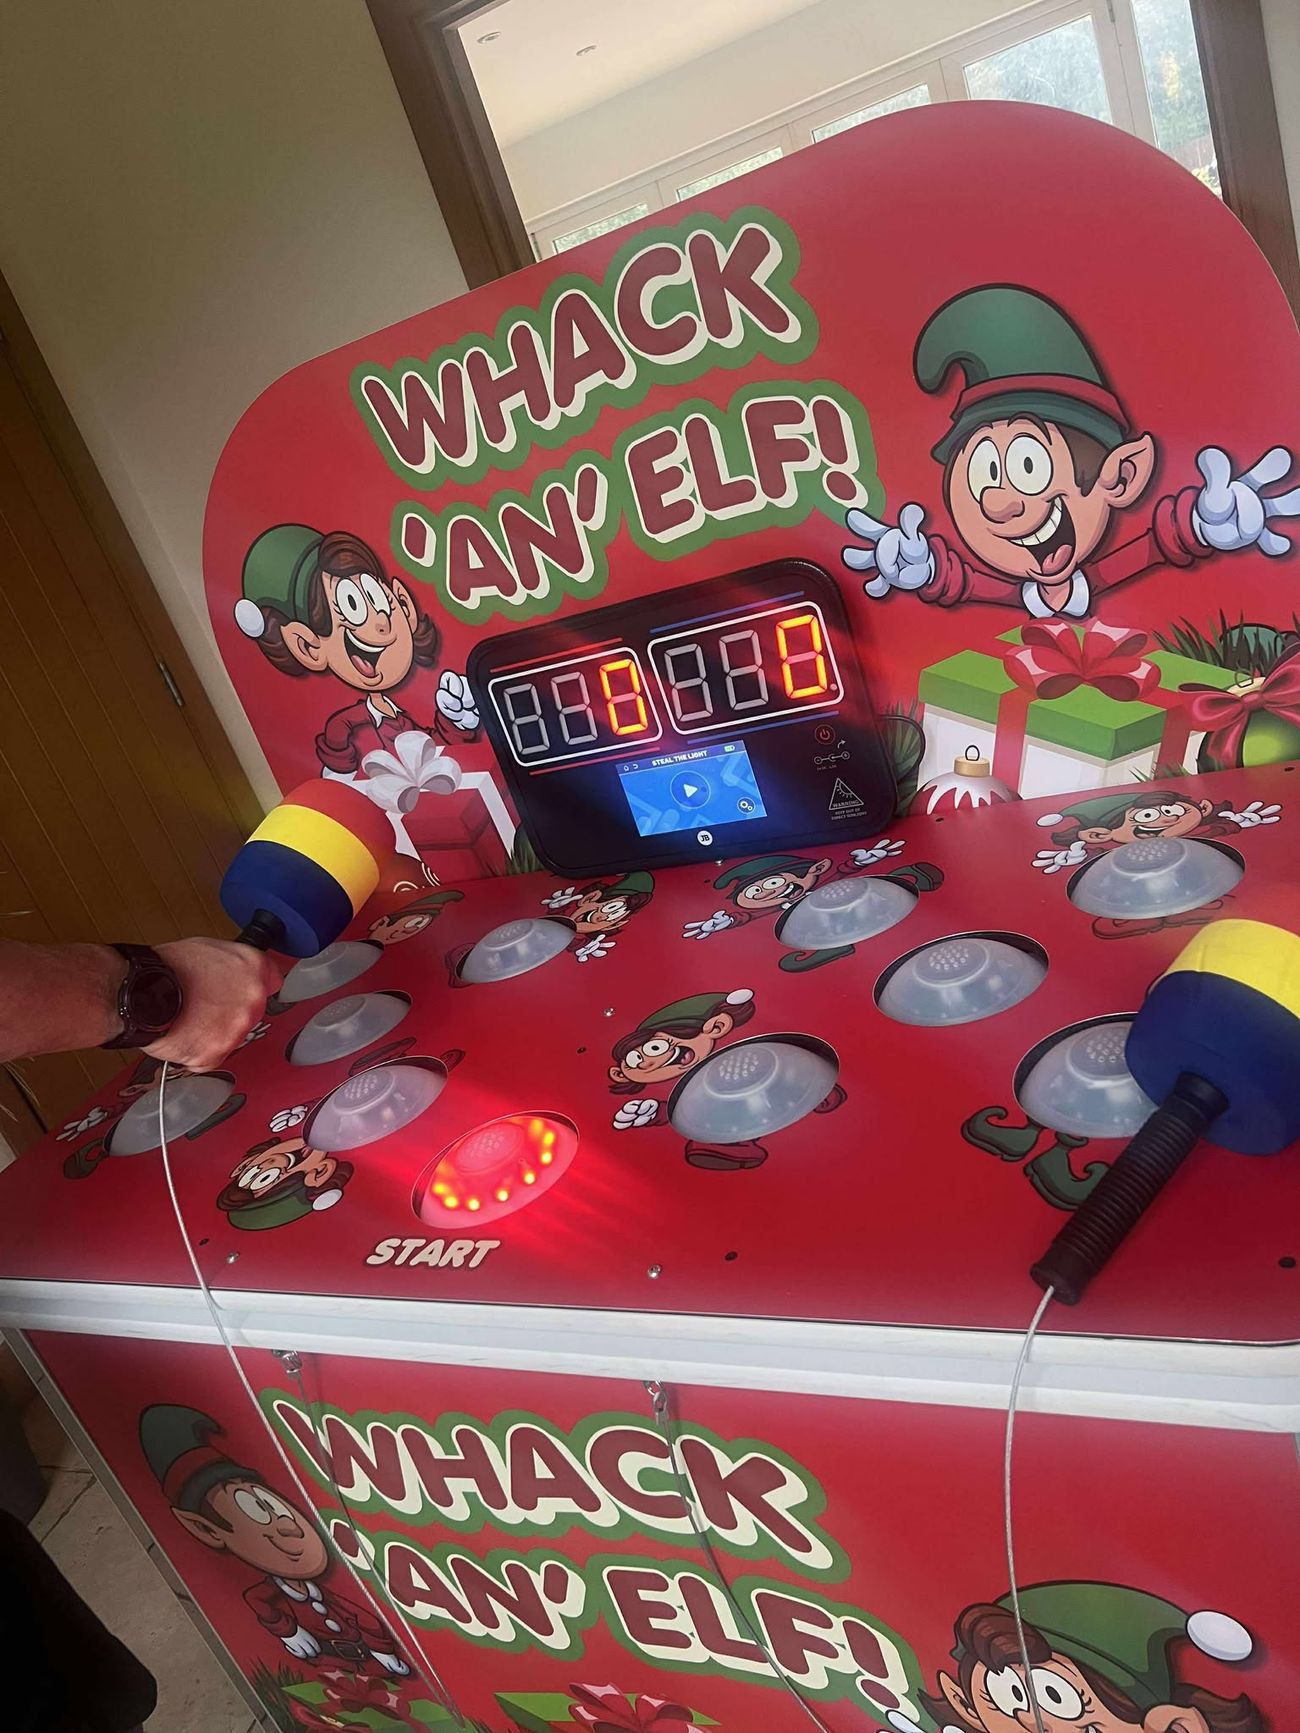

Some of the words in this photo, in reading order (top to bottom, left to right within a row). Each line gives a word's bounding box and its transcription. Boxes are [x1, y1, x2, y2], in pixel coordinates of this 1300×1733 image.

[361, 223, 802, 475] WHACK
[625, 396, 869, 544] ELF!
[599, 659, 648, 736] 0
[776, 615, 827, 699] 0
[651, 757, 674, 767] STEAL
[674, 754, 687, 762] THE
[687, 750, 708, 760] LIGHT
[366, 1236, 502, 1270] START
[273, 1399, 834, 1571] WHACK
[603, 1565, 920, 1722] ELF!
